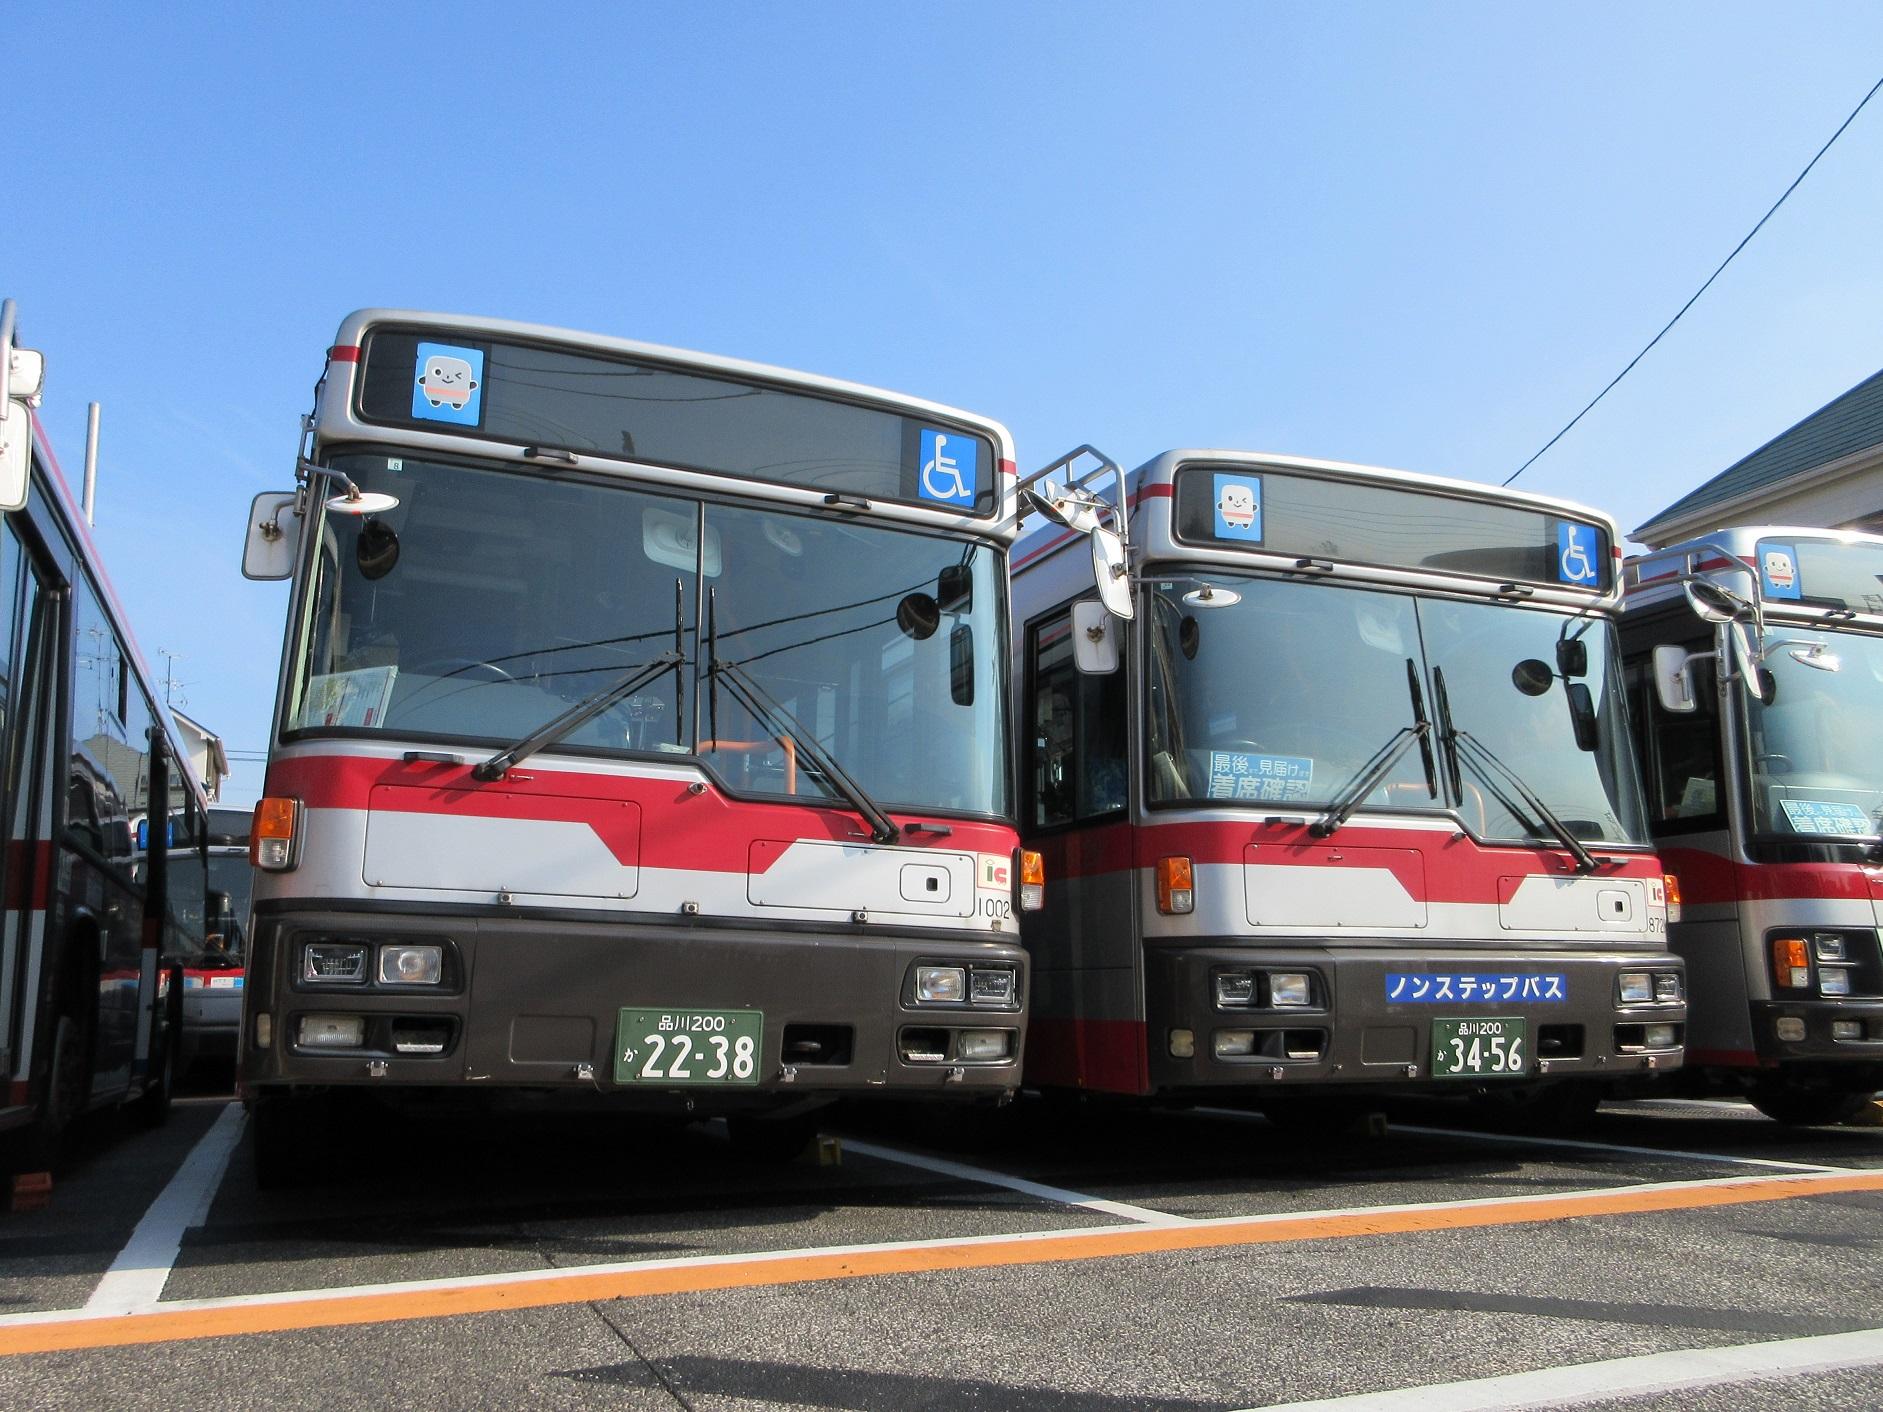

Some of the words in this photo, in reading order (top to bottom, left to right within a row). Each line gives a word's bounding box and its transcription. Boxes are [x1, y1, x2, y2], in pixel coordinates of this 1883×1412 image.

[979, 897, 1010, 920] 1002
[1390, 976, 1562, 999] ノンステップバス
[623, 1047, 638, 1062] か
